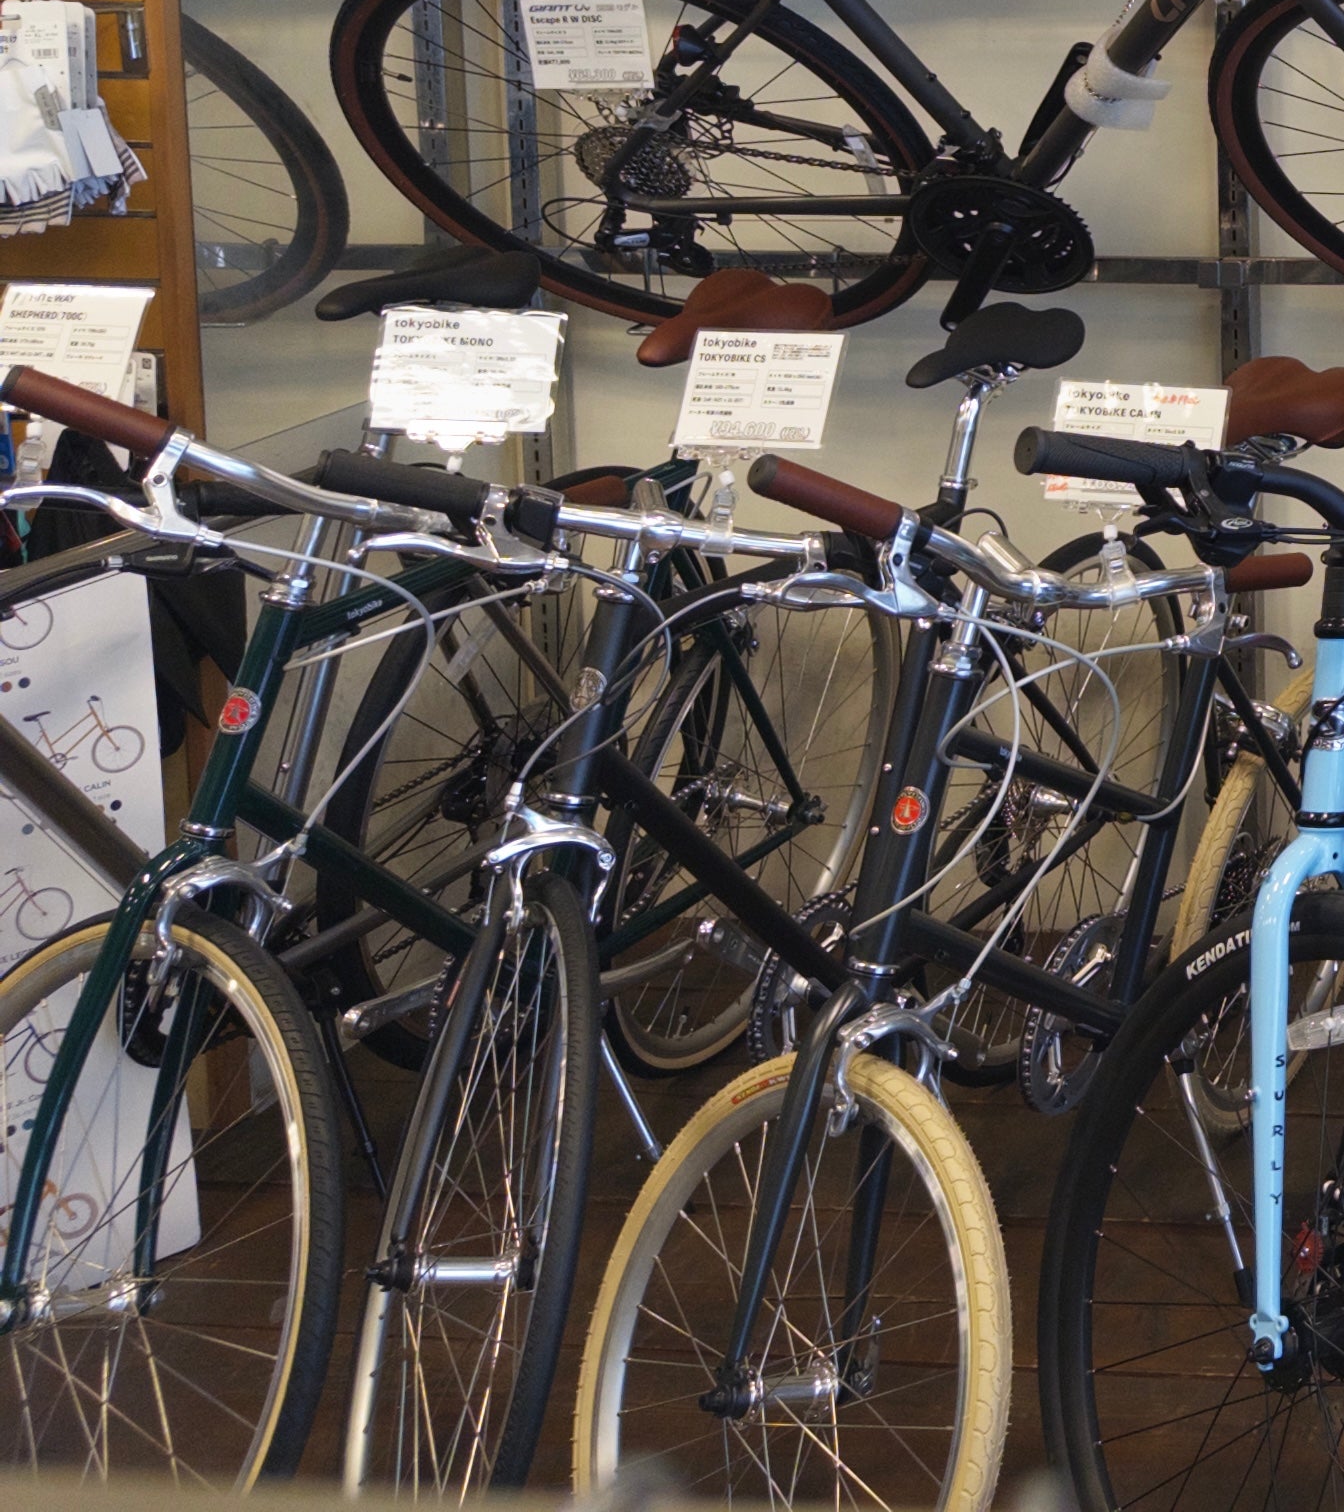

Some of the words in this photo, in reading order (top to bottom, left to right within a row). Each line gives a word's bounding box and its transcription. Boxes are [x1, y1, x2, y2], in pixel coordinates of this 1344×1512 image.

[529, 4, 572, 12] GIANT
[530, 16, 560, 25] Escape
[582, 15, 603, 24] DISC
[394, 319, 460, 332] tokyobike
[703, 338, 757, 350] tokyobike
[700, 353, 751, 363] TOKYOBIKE
[754, 355, 767, 363] CS
[84, 780, 112, 792] CALIN
[1270, 1054, 1286, 1205] SURLY
